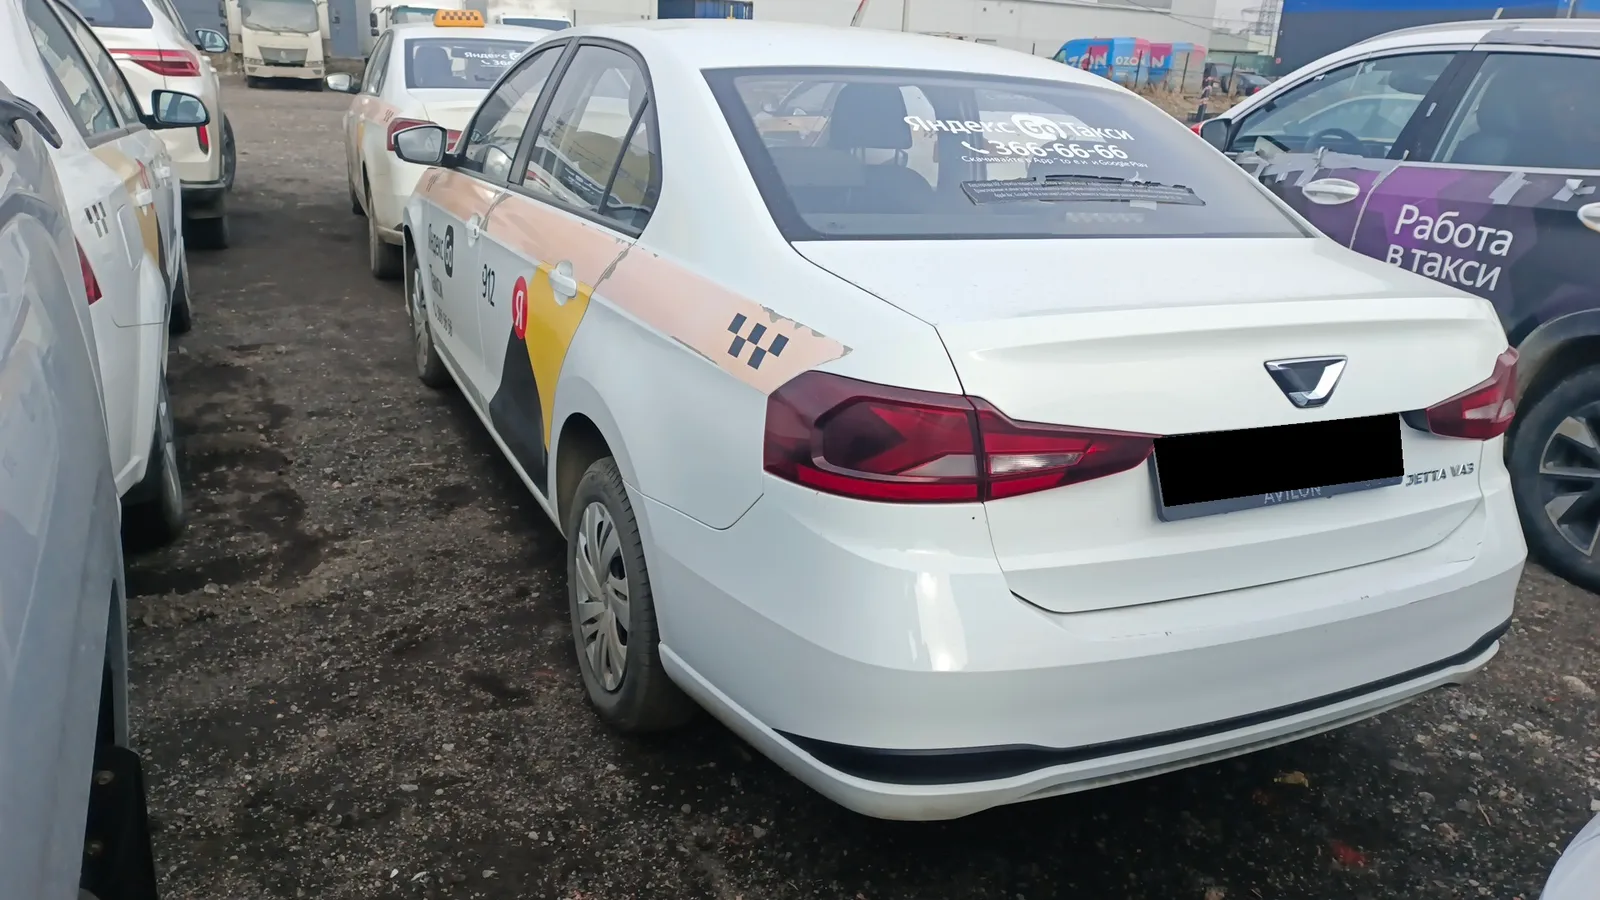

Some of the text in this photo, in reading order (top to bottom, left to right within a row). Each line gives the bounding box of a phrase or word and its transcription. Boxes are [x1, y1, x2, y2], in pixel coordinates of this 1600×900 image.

[464, 51, 508, 59] Яндекс
[1064, 52, 1107, 68] ZON
[904, 115, 1016, 134] Яндекс
[1060, 121, 1135, 140] Такси
[961, 155, 1024, 163] Скачивайте
[988, 140, 1128, 159] 366-66-66
[1394, 204, 1513, 256] Работа
[1386, 244, 1501, 291] в такси
[482, 264, 495, 307] 912
[515, 290, 524, 330] Я
[1406, 468, 1447, 487] JETTA
[1450, 463, 1474, 477] VA3
